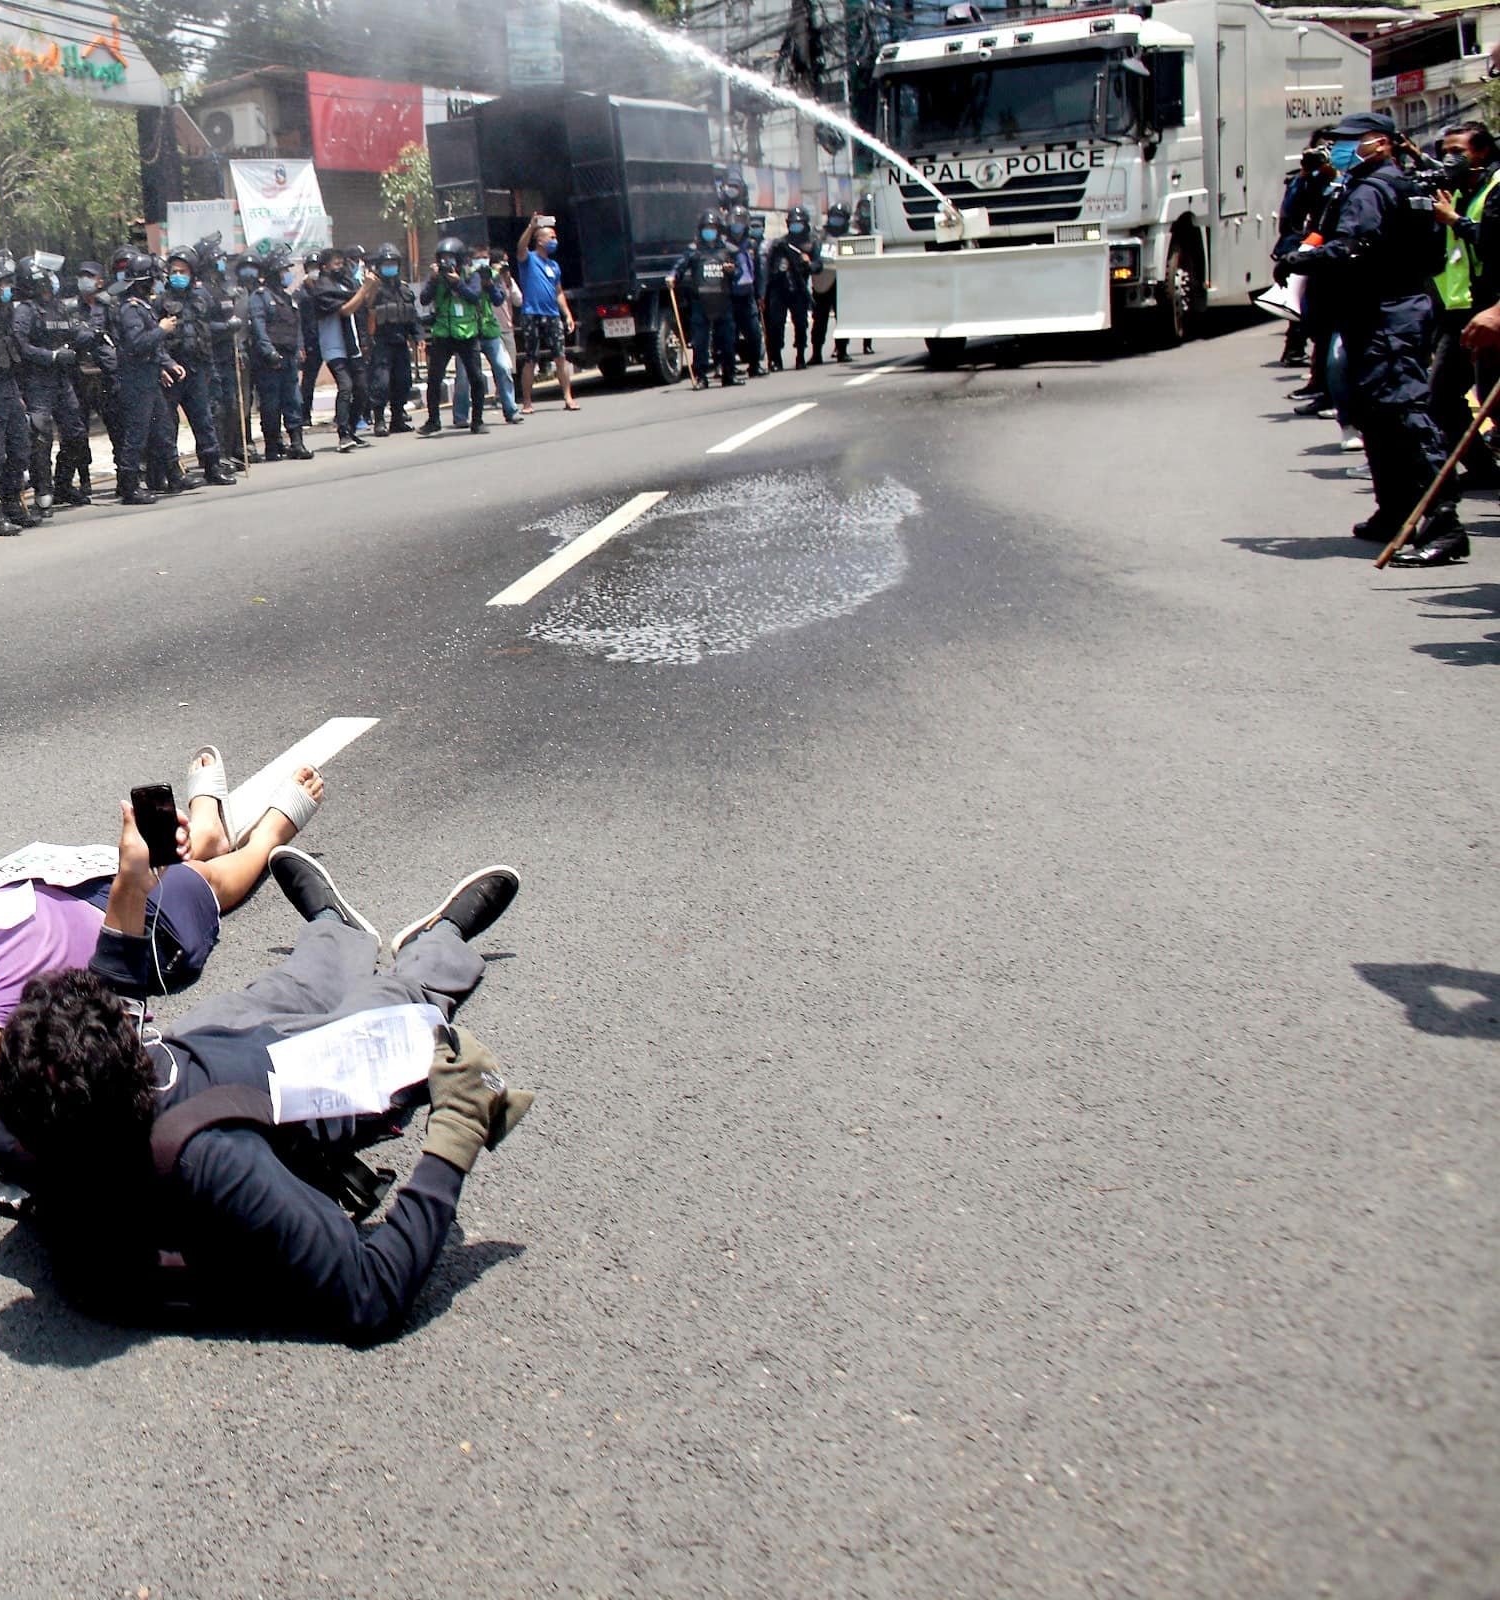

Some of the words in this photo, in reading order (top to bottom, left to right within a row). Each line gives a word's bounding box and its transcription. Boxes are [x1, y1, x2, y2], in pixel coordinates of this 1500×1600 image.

[1286, 98, 1312, 119] NEPAL
[1316, 96, 1343, 117] POLICE
[1006, 150, 1105, 175] POLICE
